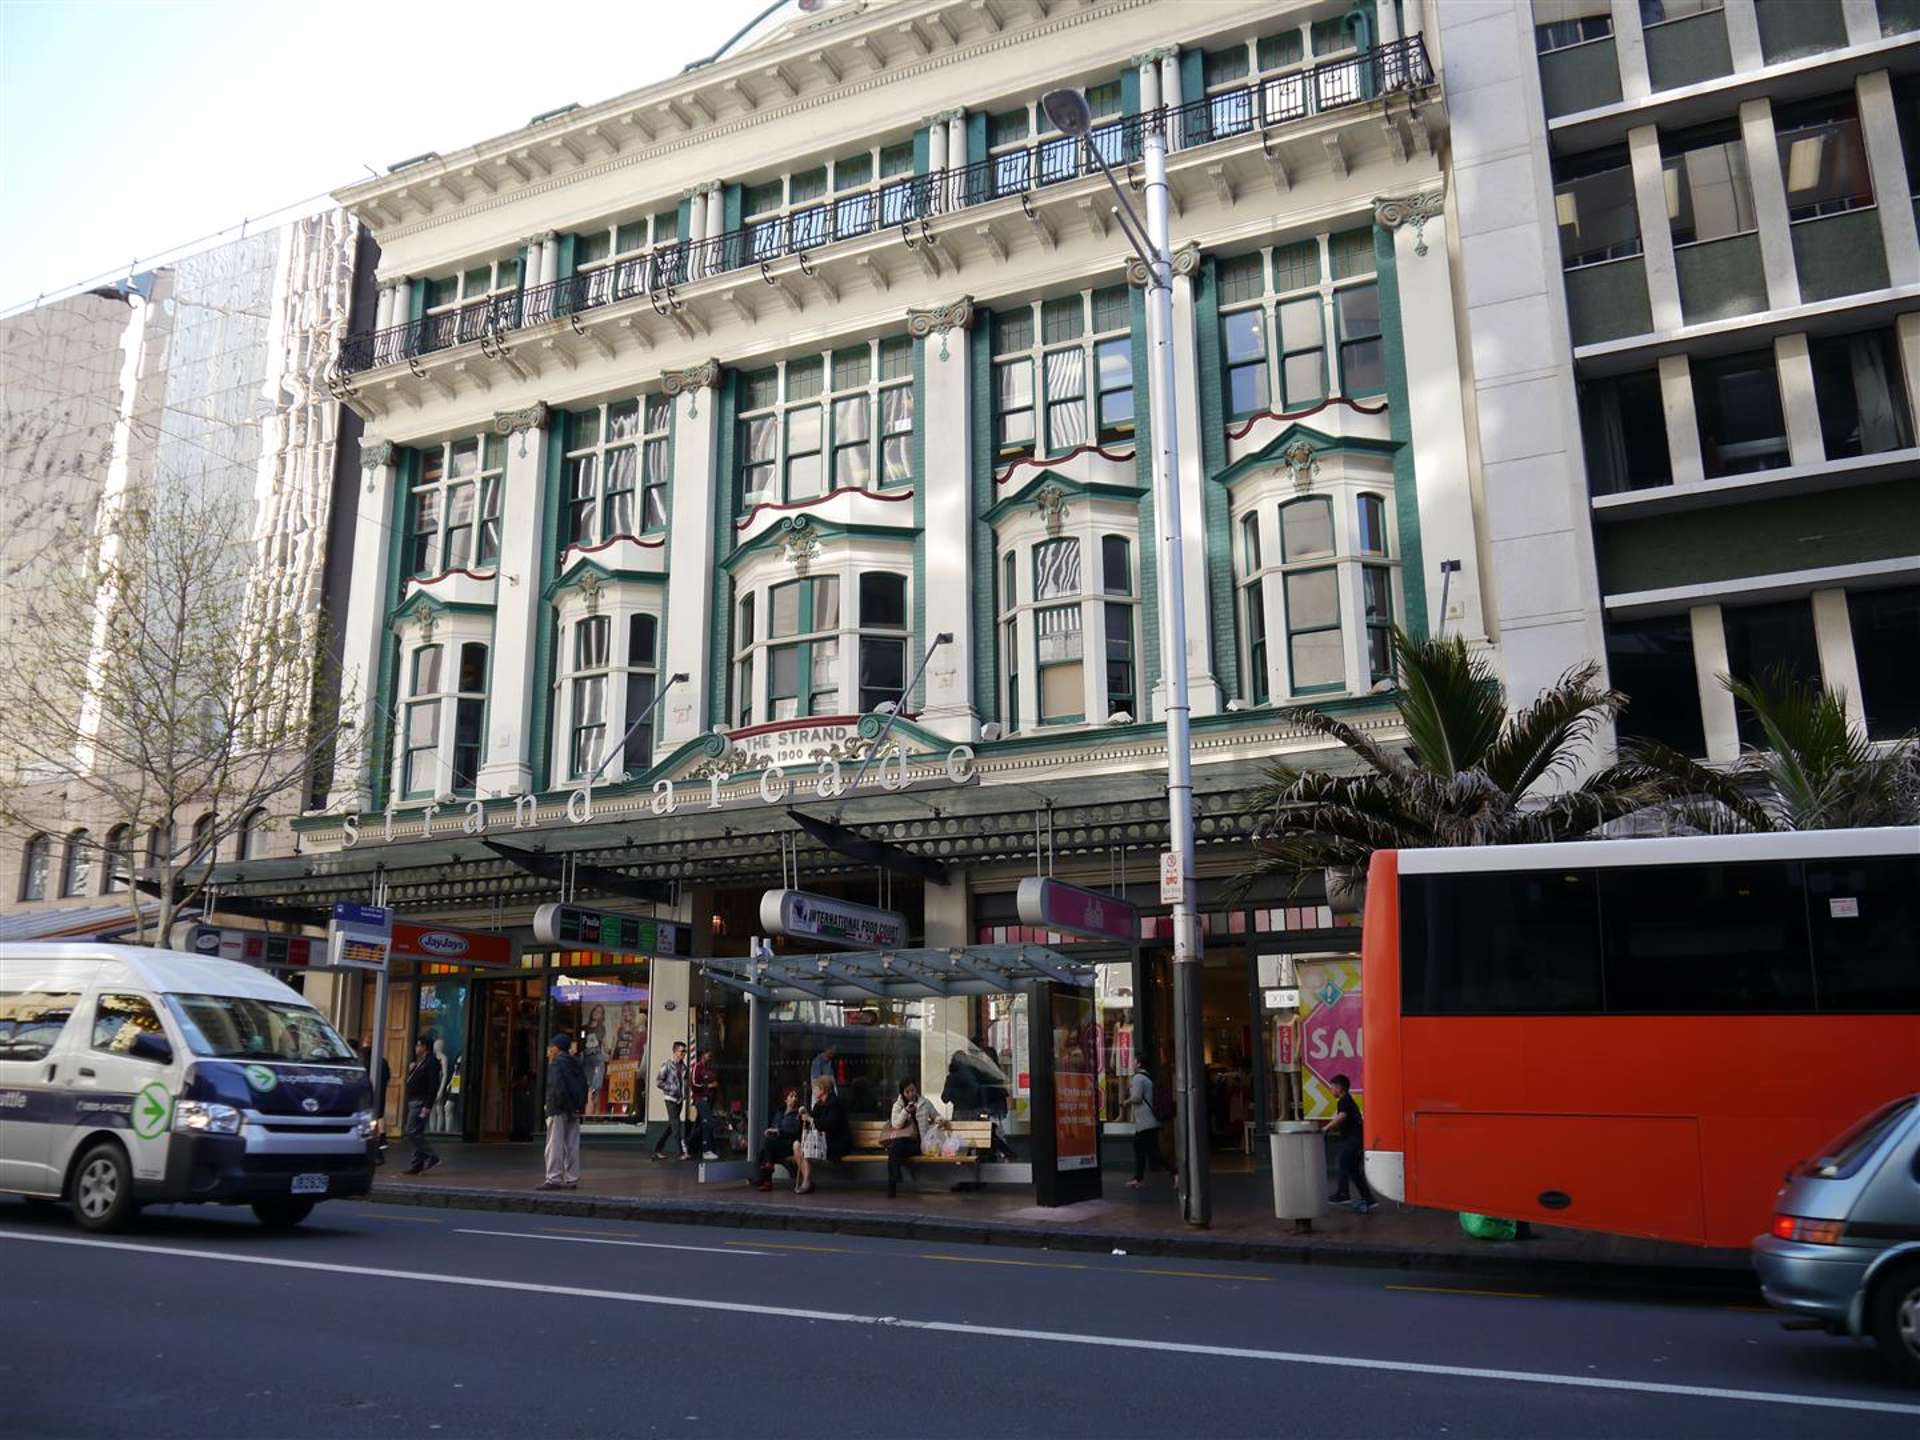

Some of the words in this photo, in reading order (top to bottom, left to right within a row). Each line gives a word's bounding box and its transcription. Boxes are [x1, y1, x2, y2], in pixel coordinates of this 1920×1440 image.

[745, 736, 772, 751] THE
[777, 726, 849, 747] STRAND
[777, 750, 804, 762] 1900
[342, 780, 595, 847] strand
[651, 742, 977, 815] arcade
[808, 910, 860, 930] INTERNATIONAL
[862, 919, 878, 932] FOOD
[424, 936, 464, 951] JayJays
